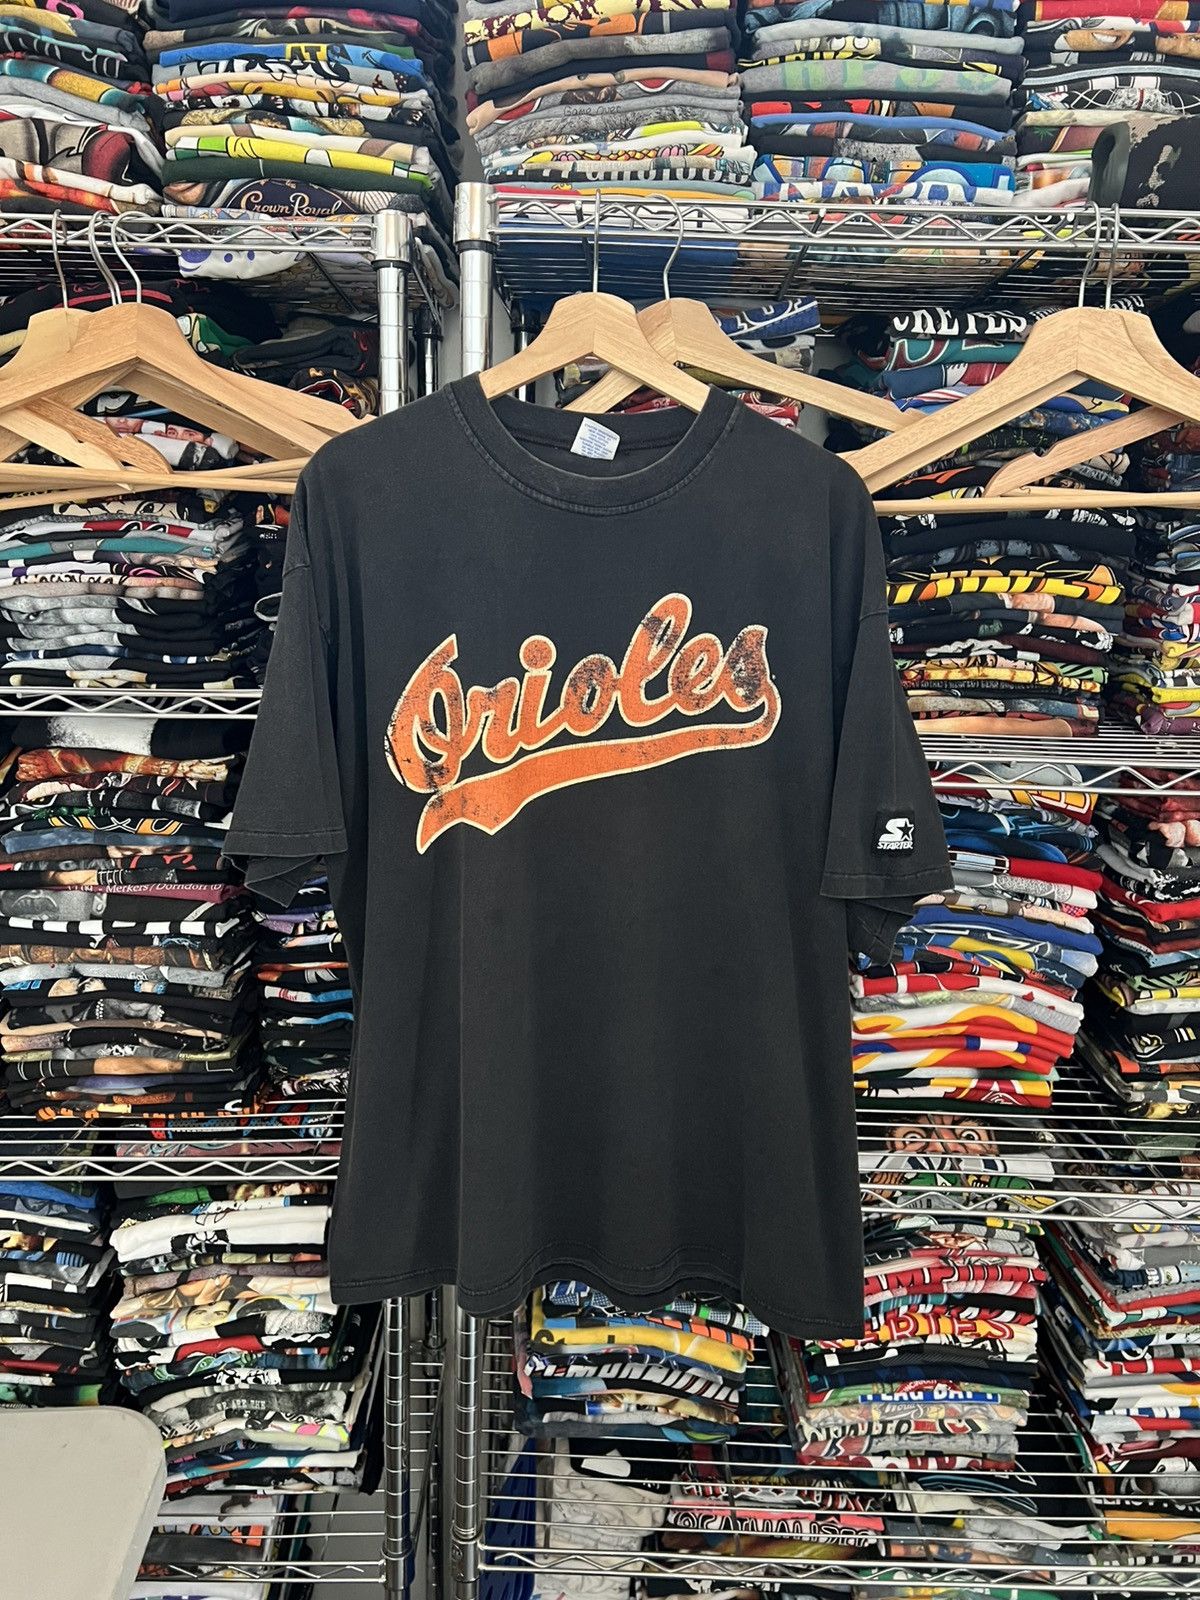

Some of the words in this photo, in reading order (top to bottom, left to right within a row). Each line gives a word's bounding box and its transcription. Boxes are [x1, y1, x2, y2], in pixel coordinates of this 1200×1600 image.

[240, 190, 291, 213] Crown
[289, 192, 342, 217] Royal
[384, 592, 782, 794] Orioles
[876, 841, 914, 850] STARTER
